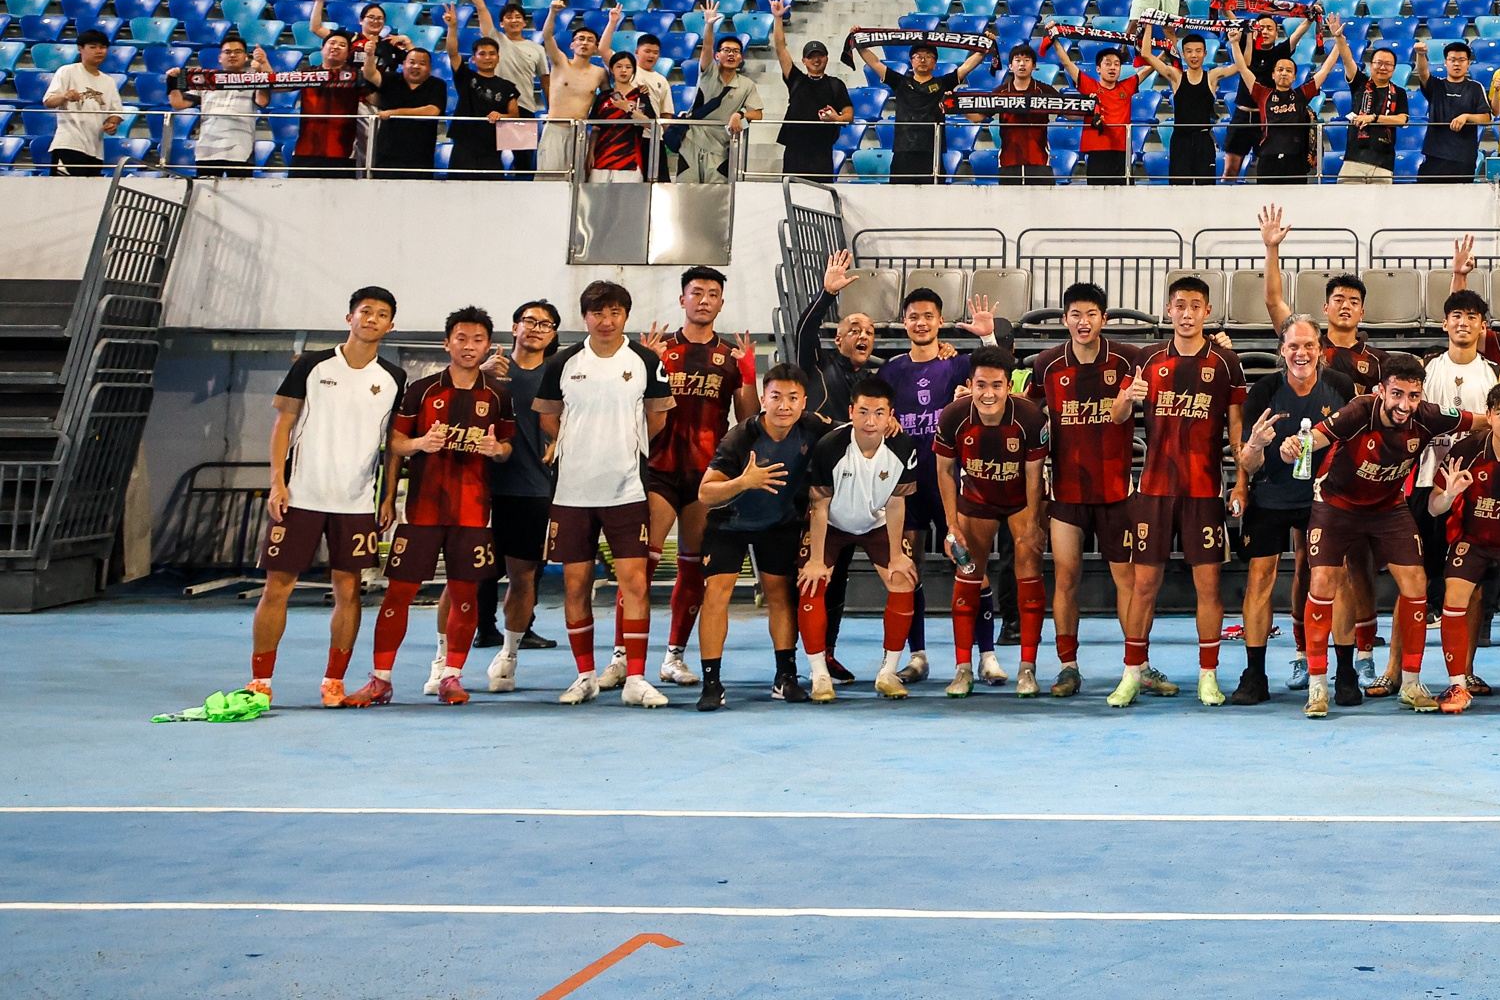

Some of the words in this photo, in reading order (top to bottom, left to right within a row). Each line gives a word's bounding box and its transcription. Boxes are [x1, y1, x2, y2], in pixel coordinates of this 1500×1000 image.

[854, 31, 923, 45] 吾心向陕
[927, 31, 995, 49] 联合无畏
[958, 96, 1026, 110] 吾心向陕
[1030, 96, 1096, 112] 联合无畏
[669, 370, 724, 390] 速力奥
[692, 389, 719, 398] AURA
[1157, 389, 1213, 410] 速力奥
[1060, 416, 1086, 426] SULI
[1087, 416, 1113, 425] AUR
[1155, 408, 1180, 417] SULI
[1180, 408, 1209, 420] AURA
[966, 457, 1020, 475] 速力奥
[1473, 510, 1500, 520] SULI
[351, 531, 378, 557] 20
[1202, 526, 1224, 549] 33
[472, 543, 495, 569] 35
